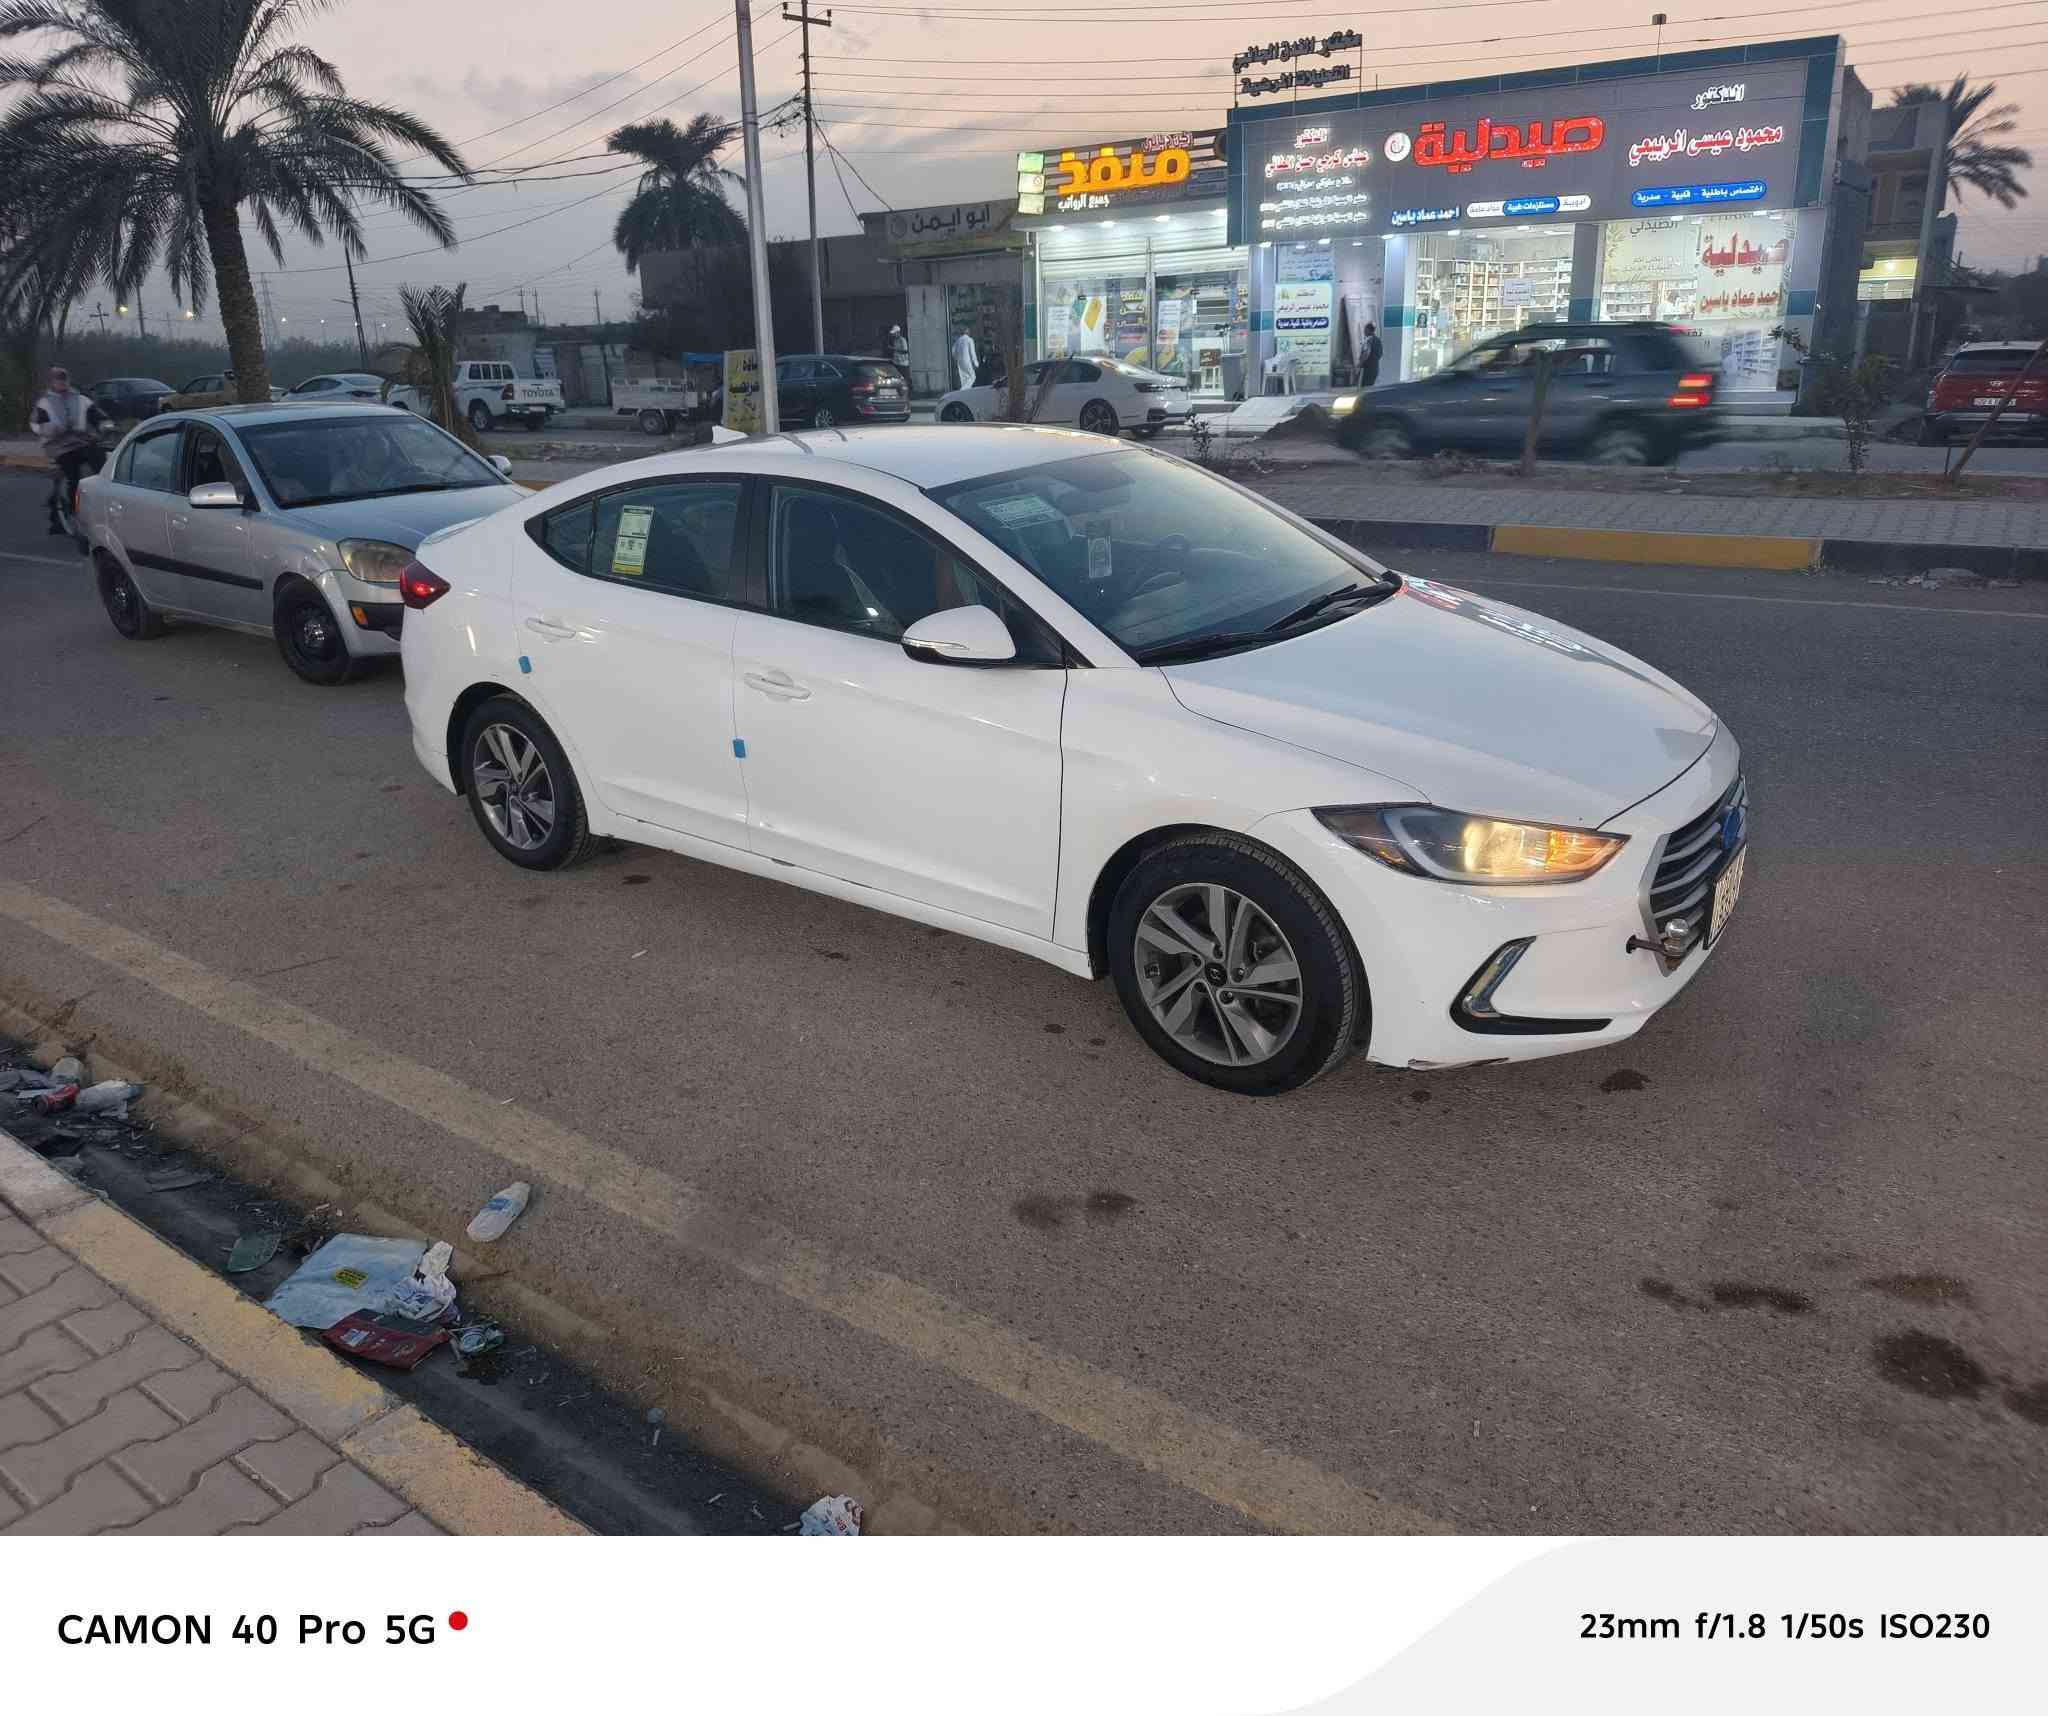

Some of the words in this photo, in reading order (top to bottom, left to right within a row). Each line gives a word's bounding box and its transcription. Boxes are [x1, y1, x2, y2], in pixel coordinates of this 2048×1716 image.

[1690, 84, 1745, 109] الدكتور
[1413, 115, 1606, 173] صيدلية
[1629, 128, 1688, 166] الربيعي
[1687, 130, 1734, 157] عيسى
[1735, 126, 1784, 152] محمود
[1056, 147, 1191, 196] منفذ
[1438, 206, 1460, 221] احمد
[1701, 231, 1789, 277] صيدلية
[1757, 286, 1783, 305] احمد
[521, 389, 555, 399] TOYOTA
